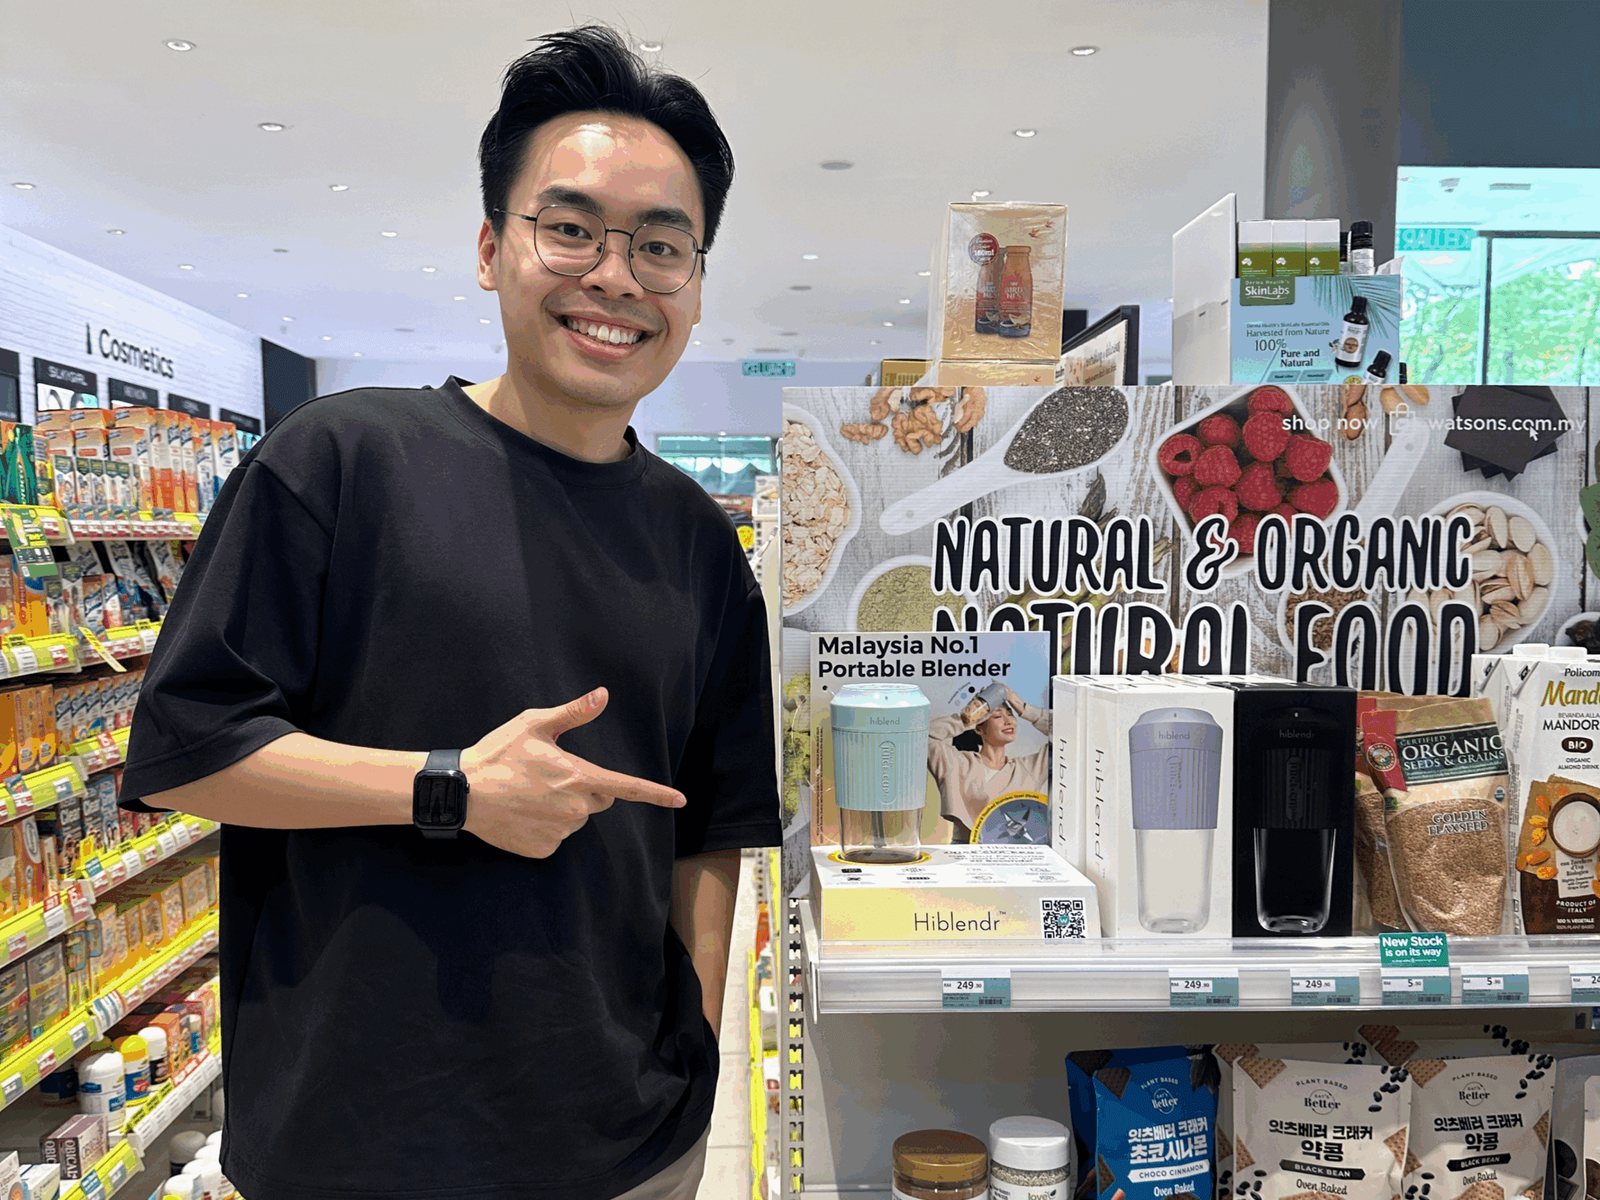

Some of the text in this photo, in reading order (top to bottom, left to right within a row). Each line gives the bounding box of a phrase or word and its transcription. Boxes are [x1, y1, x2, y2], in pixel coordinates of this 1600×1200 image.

[1245, 286, 1290, 296] SkinLabs
[1246, 329, 1283, 337] Harvested
[1256, 338, 1287, 351] 100%
[100, 328, 174, 379] Cosmetics
[1280, 350, 1300, 358] Pure
[1280, 358, 1312, 367] Natural
[1282, 414, 1329, 432] shop
[1337, 418, 1378, 430] now
[933, 514, 1472, 594] NATURAL & ORGANIC
[818, 636, 978, 659] Malaysia No.1
[818, 660, 1011, 678] Portable Blender
[1400, 735, 1446, 746] CERTIFIED
[1402, 734, 1504, 761] ORGANIC
[1568, 741, 1587, 750] BIO
[1404, 750, 1504, 770] SEEDS & GRAINS
[1432, 810, 1487, 824] GOLDEN
[1428, 820, 1488, 836] FLAXSEED
[1382, 936, 1443, 947] New Stock
[1385, 948, 1393, 956] is
[1409, 948, 1420, 956] its
[1422, 949, 1441, 957] way
[1452, 1072, 1498, 1080] PLANT BASED
[1324, 1080, 1348, 1090] BASED
[1459, 1091, 1490, 1100] Better
[1152, 1098, 1178, 1108] Better
[1304, 1097, 1341, 1109] Better
[1269, 1119, 1373, 1140] 잇츠베러 크래커
[1434, 1113, 1524, 1132] 잇츠베러 크래커
[1128, 1117, 1208, 1143] 잇츠베러 크래커
[1465, 1132, 1499, 1151] 약콩
[1130, 1134, 1208, 1164] 초코시나몬
[1301, 1140, 1344, 1162] 약콩
[1294, 1164, 1350, 1177] BLACK BEAN
[1461, 1160, 1480, 1168] BLACK
[1139, 1164, 1204, 1179] CHOCO CINNAMON
[1477, 1170, 1497, 1181] Baked
[1154, 1181, 1195, 1197] Oven Baked
[1296, 1179, 1348, 1196] Oven Baked
